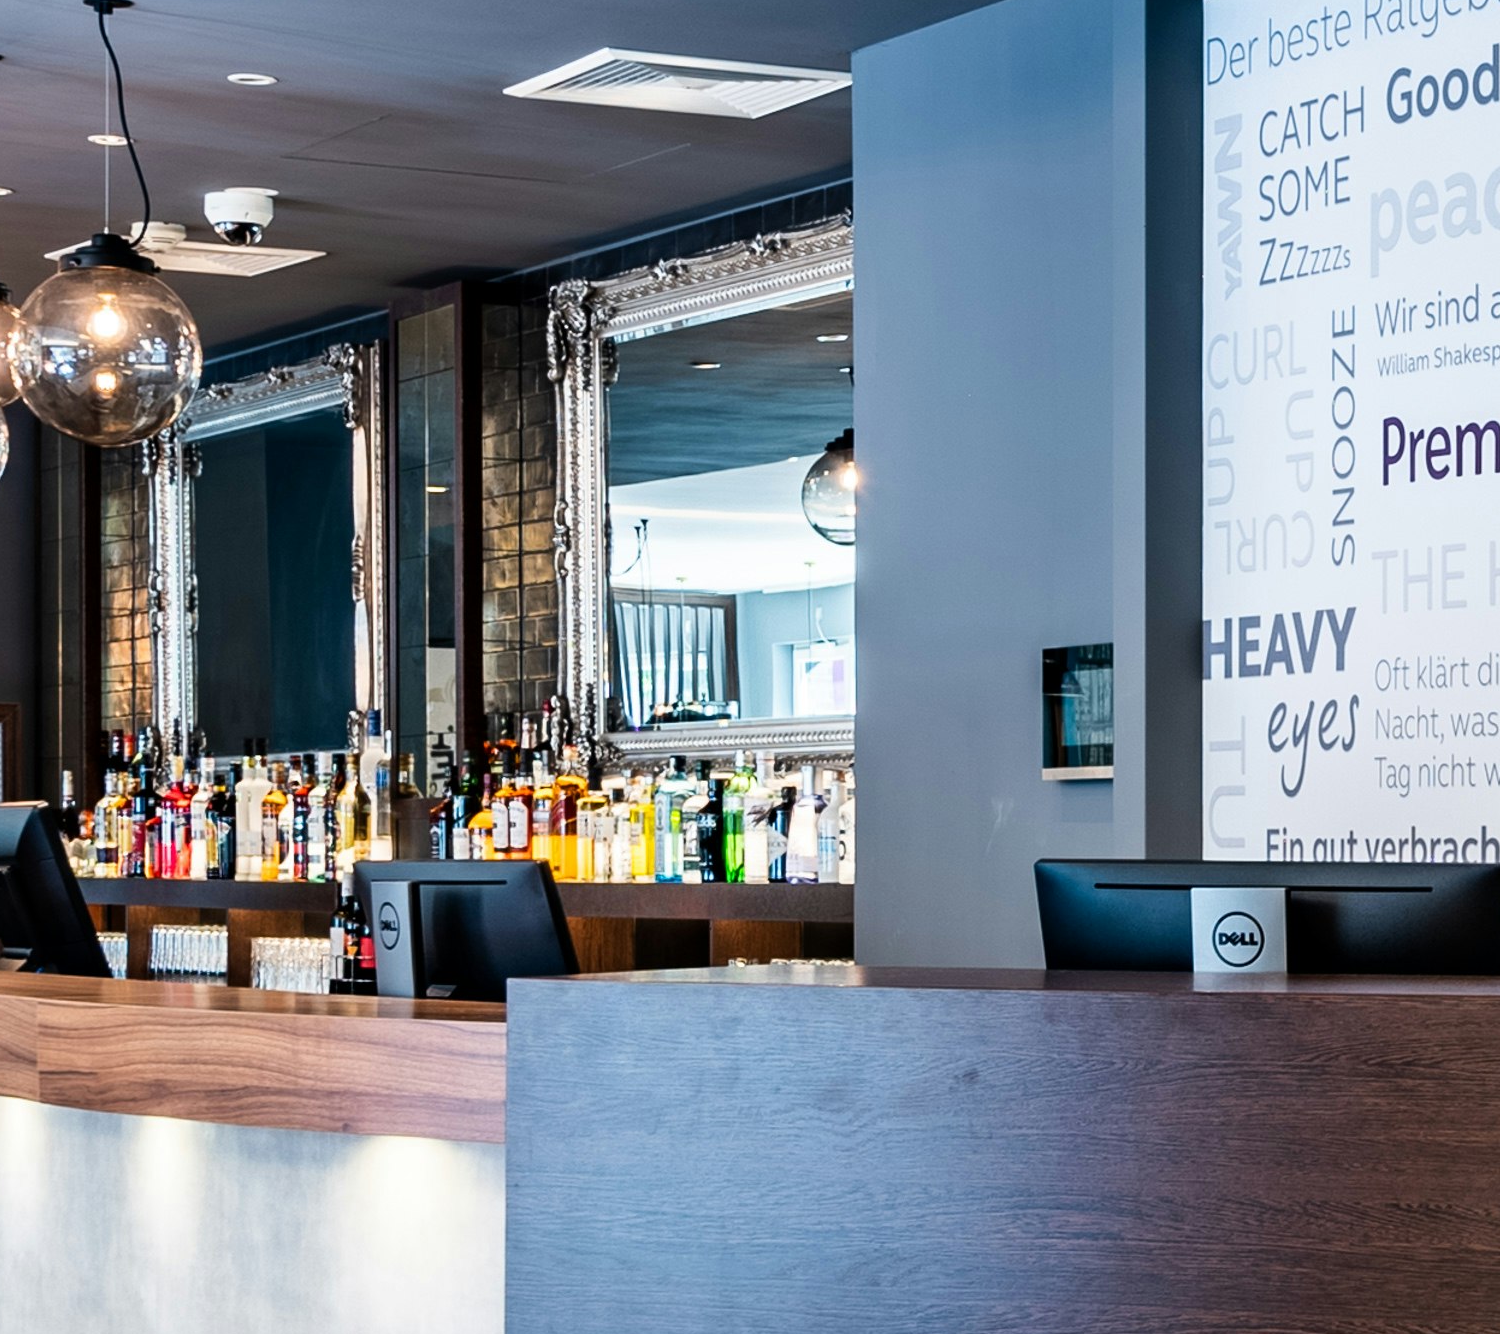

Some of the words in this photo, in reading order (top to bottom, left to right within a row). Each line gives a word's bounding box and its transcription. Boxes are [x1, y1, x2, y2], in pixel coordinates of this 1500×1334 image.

[1206, 33, 1258, 85] Der
[1268, 6, 1352, 67] beste
[1386, 44, 1500, 124] Good
[1259, 85, 1365, 157] CATCH
[1214, 113, 1243, 301] YAWN
[1259, 155, 1350, 220] SOME
[1375, 297, 1418, 337] Wir
[1425, 283, 1479, 329] sind
[1207, 320, 1307, 391] CURL
[1377, 351, 1430, 377] William
[1207, 407, 1235, 507] UP
[1285, 389, 1314, 493] UP
[1331, 304, 1356, 567] SNOOZE
[1214, 510, 1315, 575] CURL
[1371, 543, 1468, 615] THE
[1202, 607, 1357, 680] HEAVY
[1375, 657, 1410, 691] Oft
[1417, 655, 1469, 689] klärt
[1267, 693, 1360, 798] eyes
[1375, 705, 1445, 744] Nacht,
[1450, 711, 1499, 737] was
[1374, 756, 1410, 798] Tag
[1418, 753, 1476, 787] nicht
[1218, 931, 1259, 946] DELL
